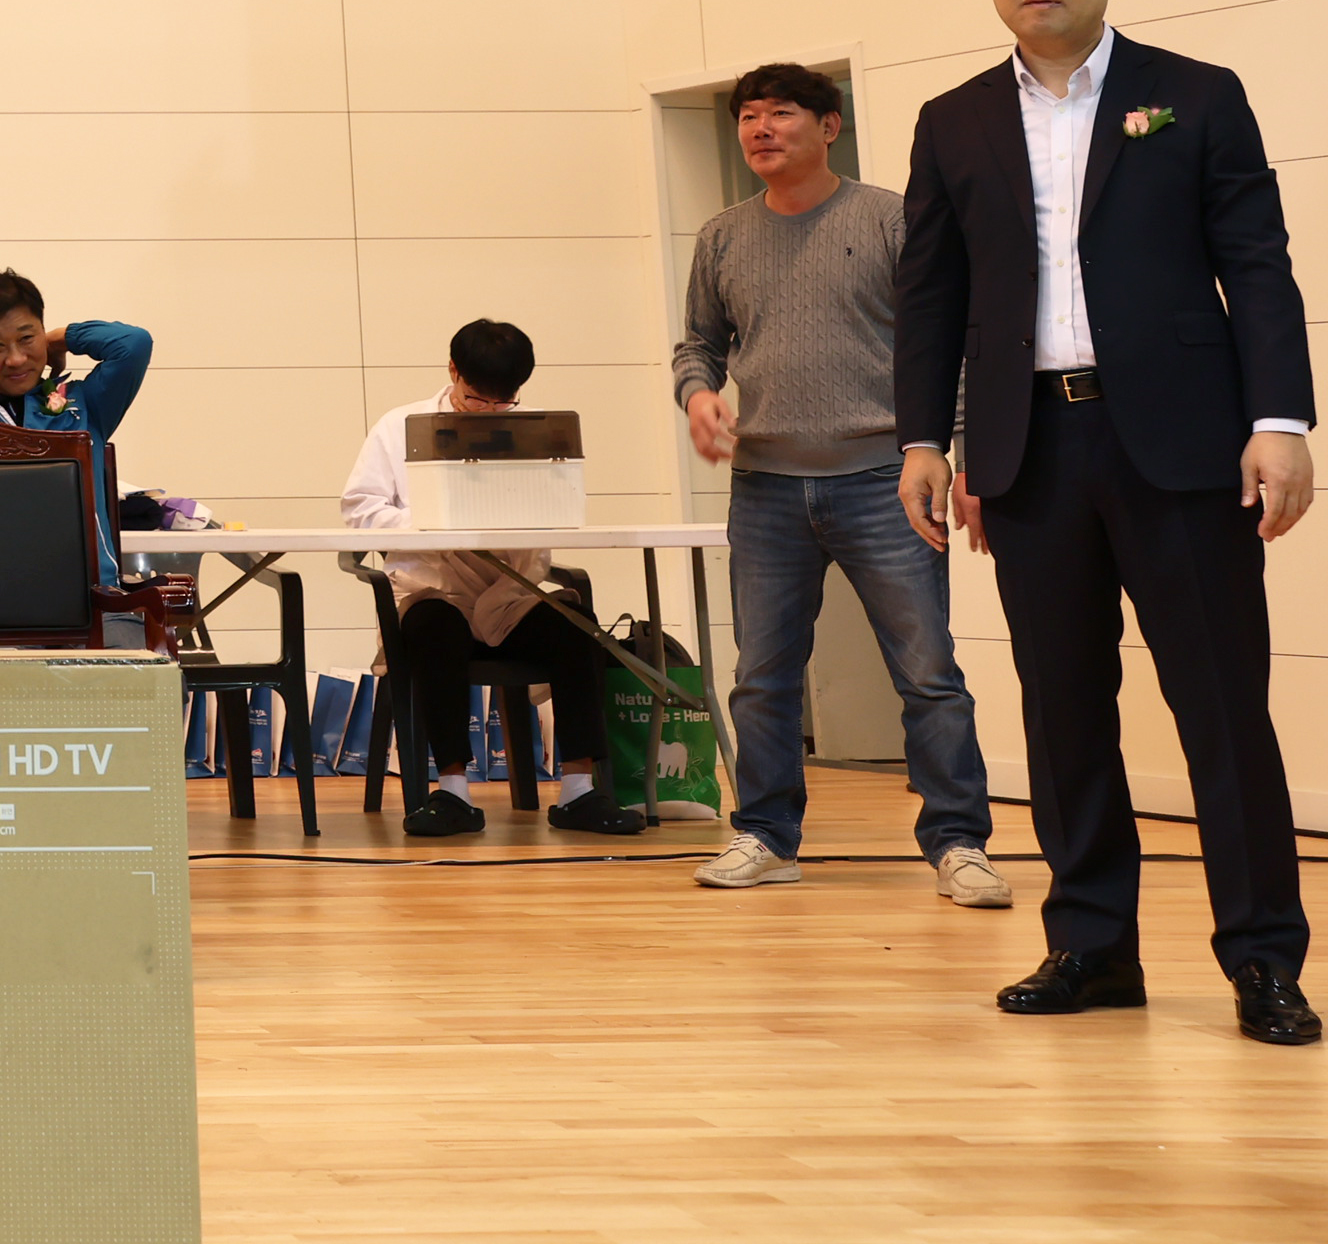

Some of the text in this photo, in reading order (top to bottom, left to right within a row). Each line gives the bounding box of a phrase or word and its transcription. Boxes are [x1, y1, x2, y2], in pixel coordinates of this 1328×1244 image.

[629, 710, 670, 723] Loe
[683, 709, 711, 723] Hero
[8, 743, 59, 775] HD
[64, 743, 113, 775] TV
